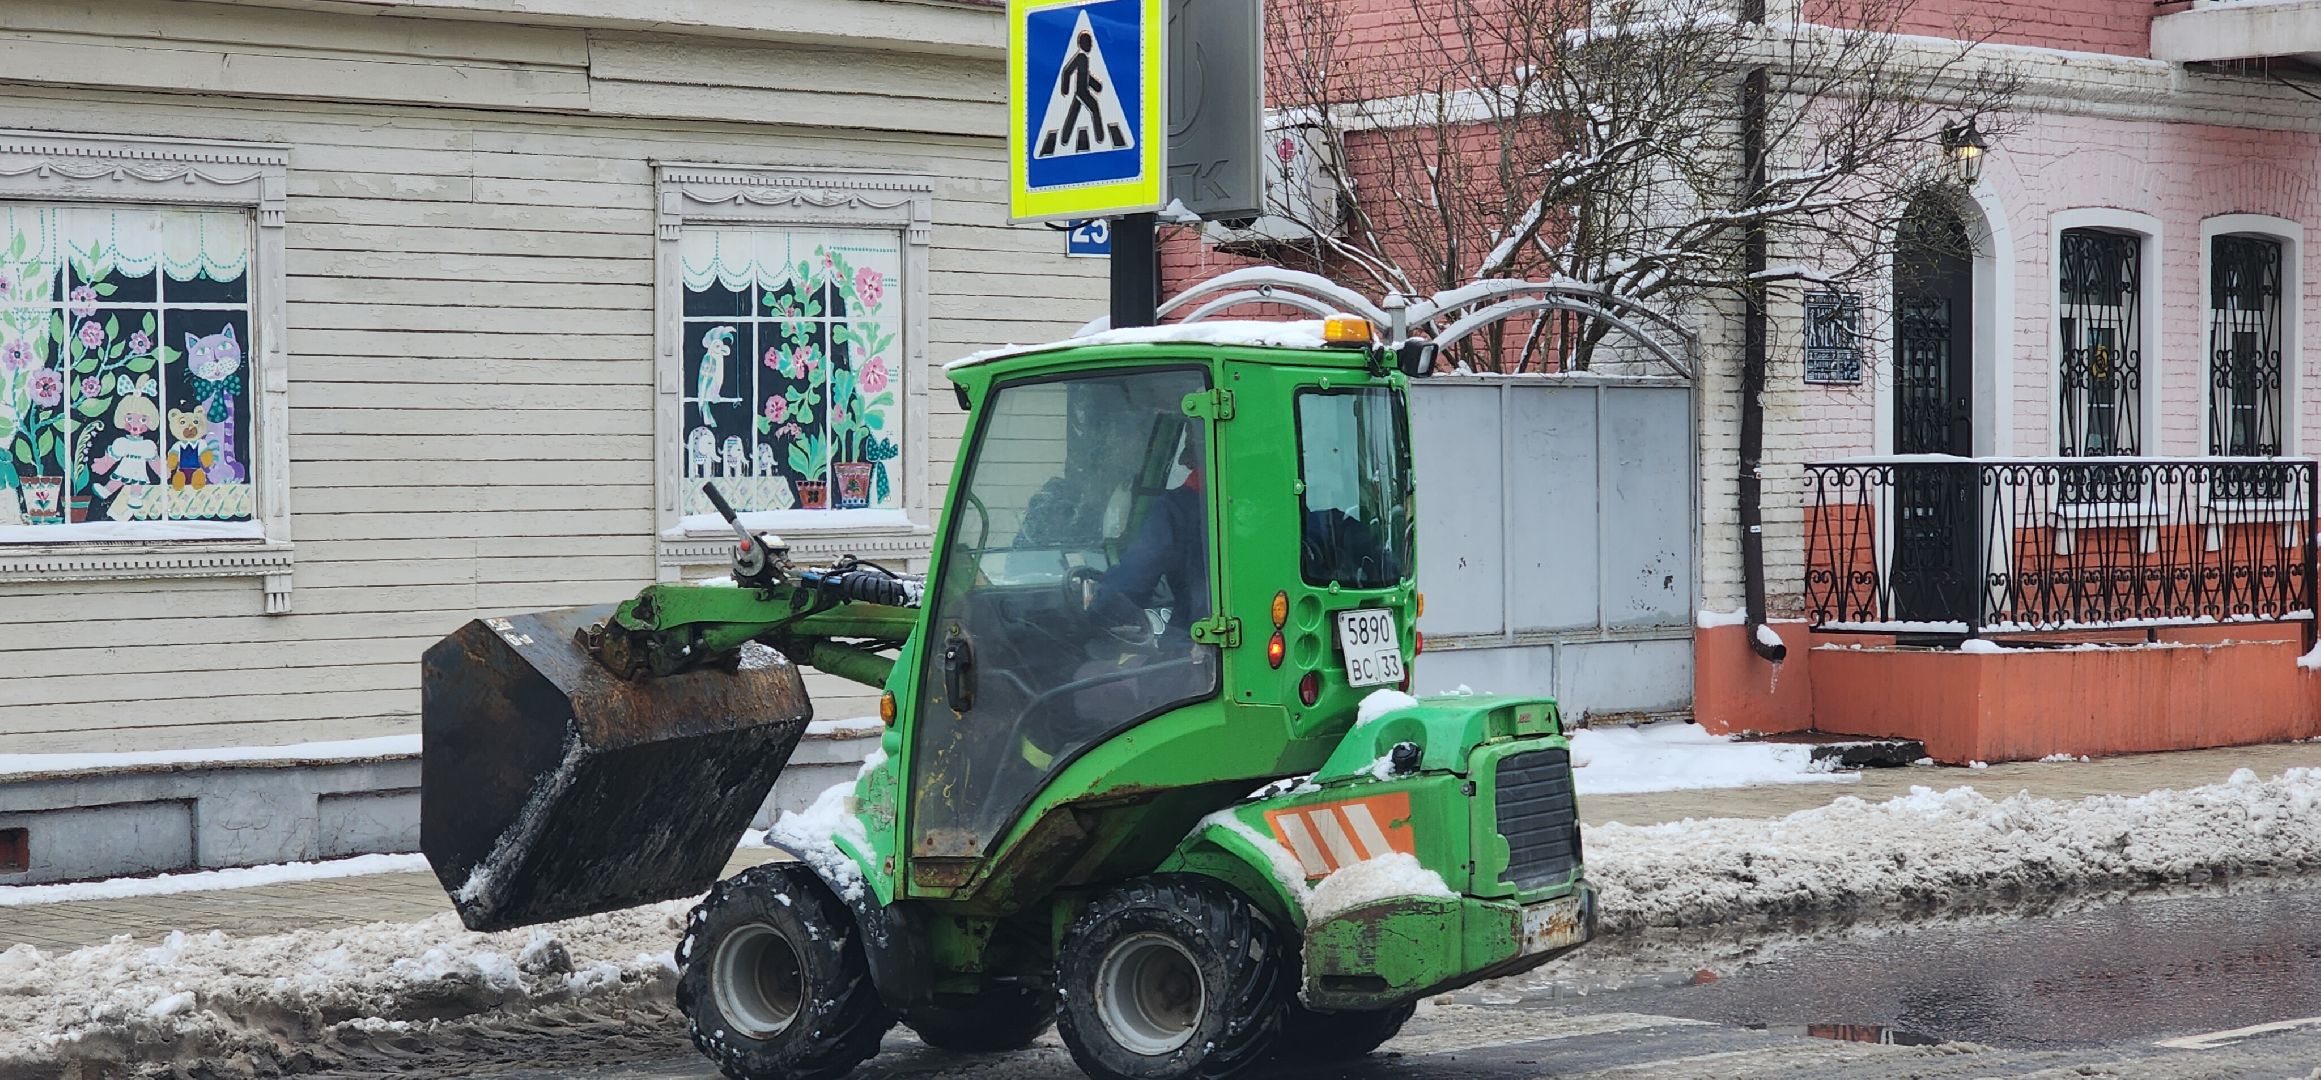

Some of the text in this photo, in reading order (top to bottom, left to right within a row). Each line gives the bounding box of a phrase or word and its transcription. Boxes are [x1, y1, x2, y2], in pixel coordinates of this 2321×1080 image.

[1348, 614, 1390, 645] 5890
[1352, 655, 1400, 681] ВС 33
